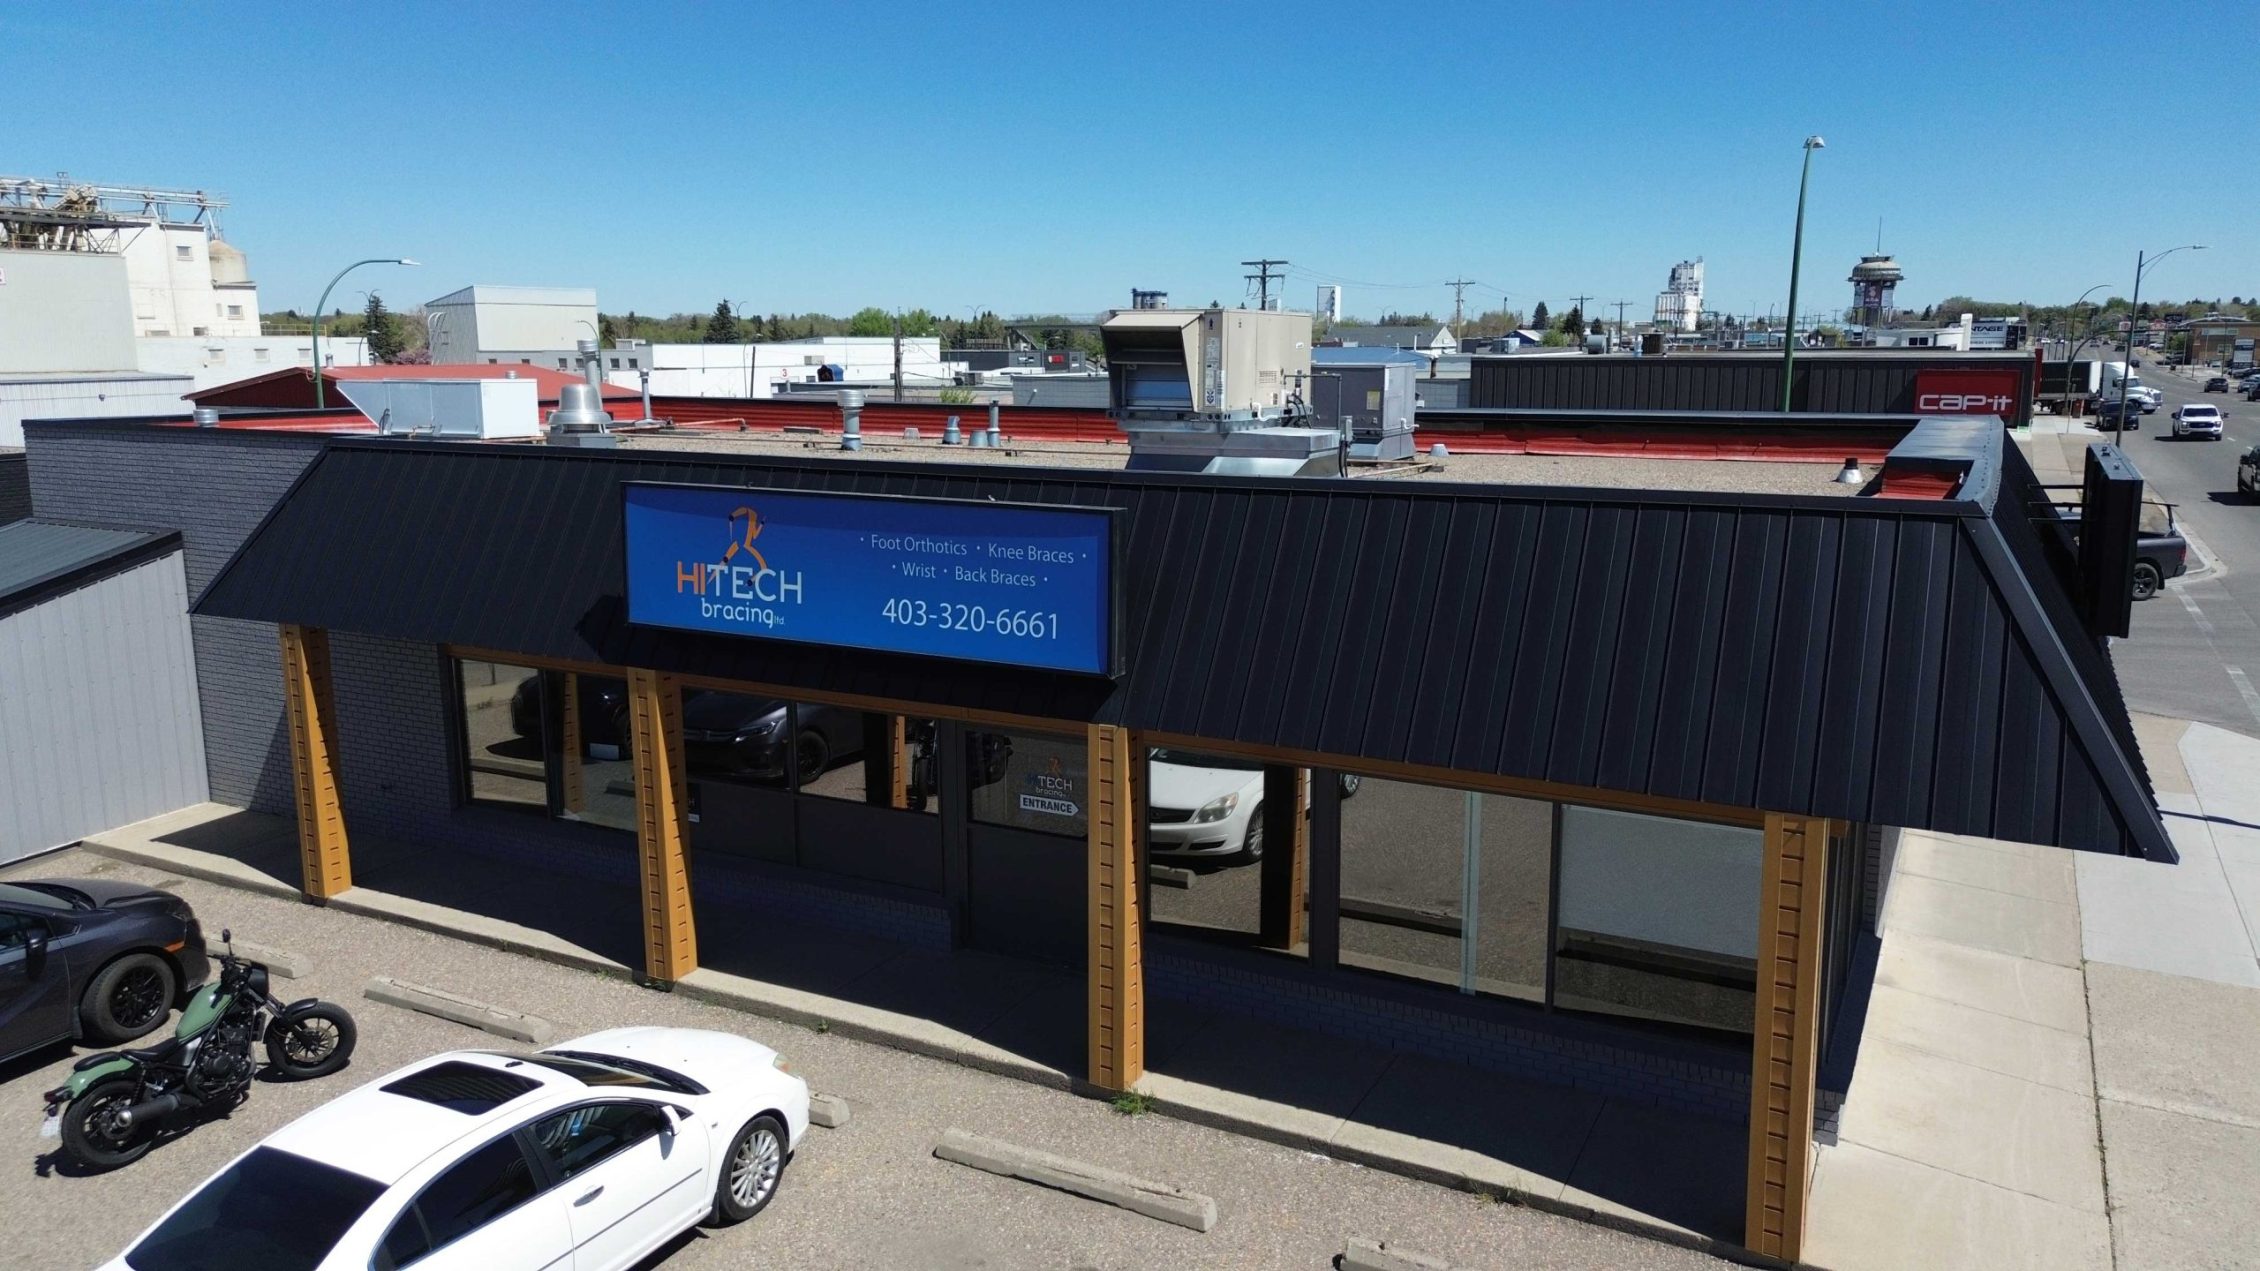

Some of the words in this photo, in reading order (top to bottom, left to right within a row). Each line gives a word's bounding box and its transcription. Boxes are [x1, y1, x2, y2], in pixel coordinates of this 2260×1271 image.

[871, 534, 901, 551] Foot
[904, 536, 967, 555] Orthotics
[988, 542, 1024, 560] Knee
[1028, 545, 1074, 564] Braces
[677, 560, 802, 605] HITECH
[902, 561, 936, 579] Wrist
[955, 565, 987, 583] Back
[991, 568, 1036, 587] Braces
[701, 597, 774, 629] bracing
[882, 598, 1057, 640] 403-320-6661
[1022, 797, 1073, 814] ENTRANCE
